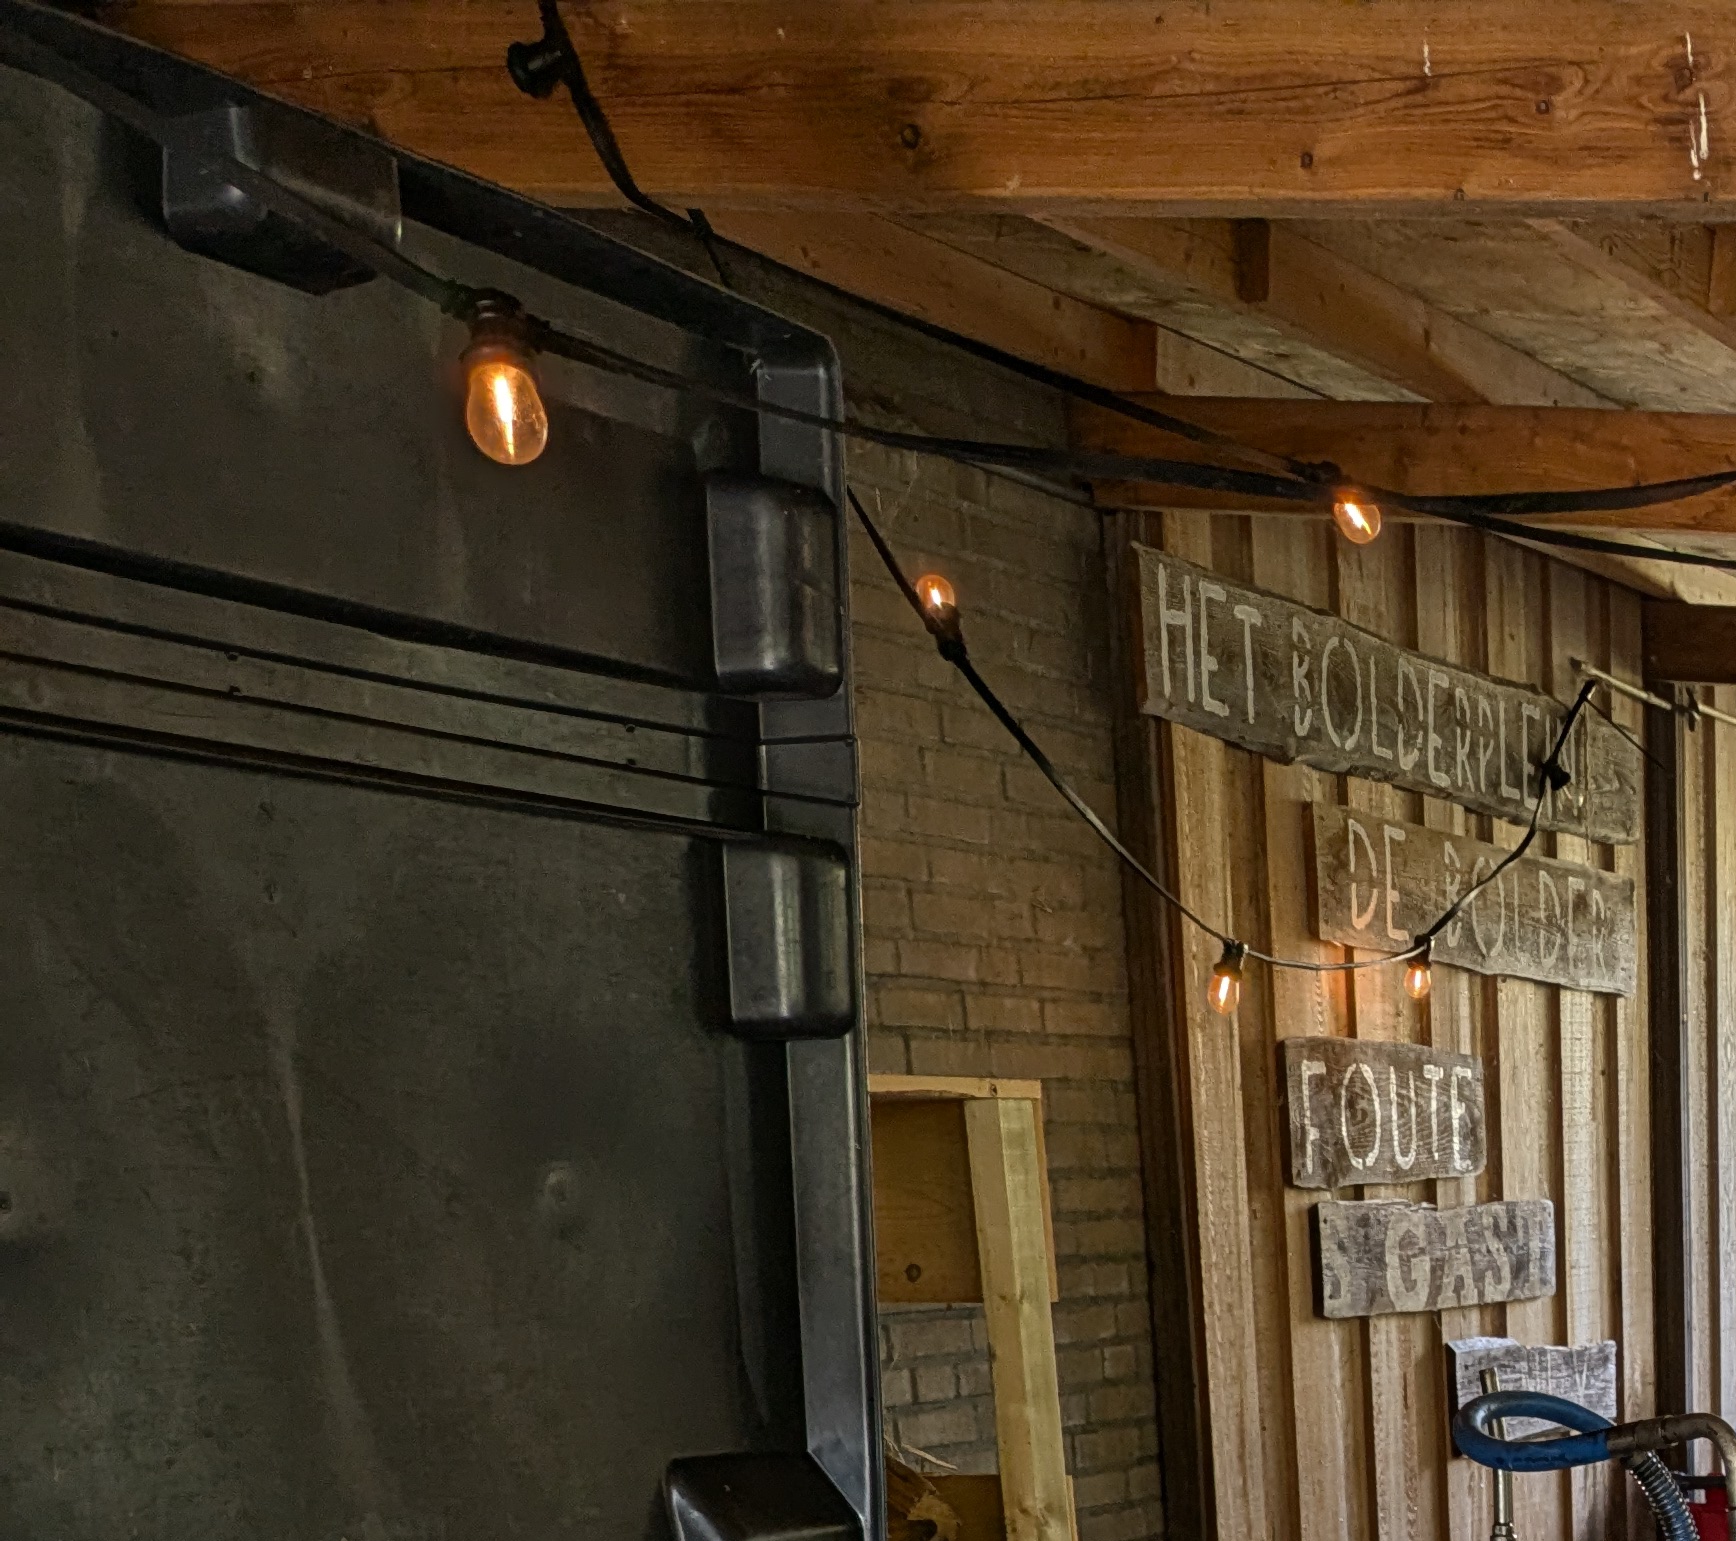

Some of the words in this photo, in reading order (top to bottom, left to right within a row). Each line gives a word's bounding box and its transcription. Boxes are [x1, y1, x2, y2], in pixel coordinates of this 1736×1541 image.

[1157, 562, 1262, 725] HET
[1347, 818, 1408, 942] DE
[1443, 841, 1606, 976] BOLDER
[1301, 1059, 1473, 1174] FOUTE
